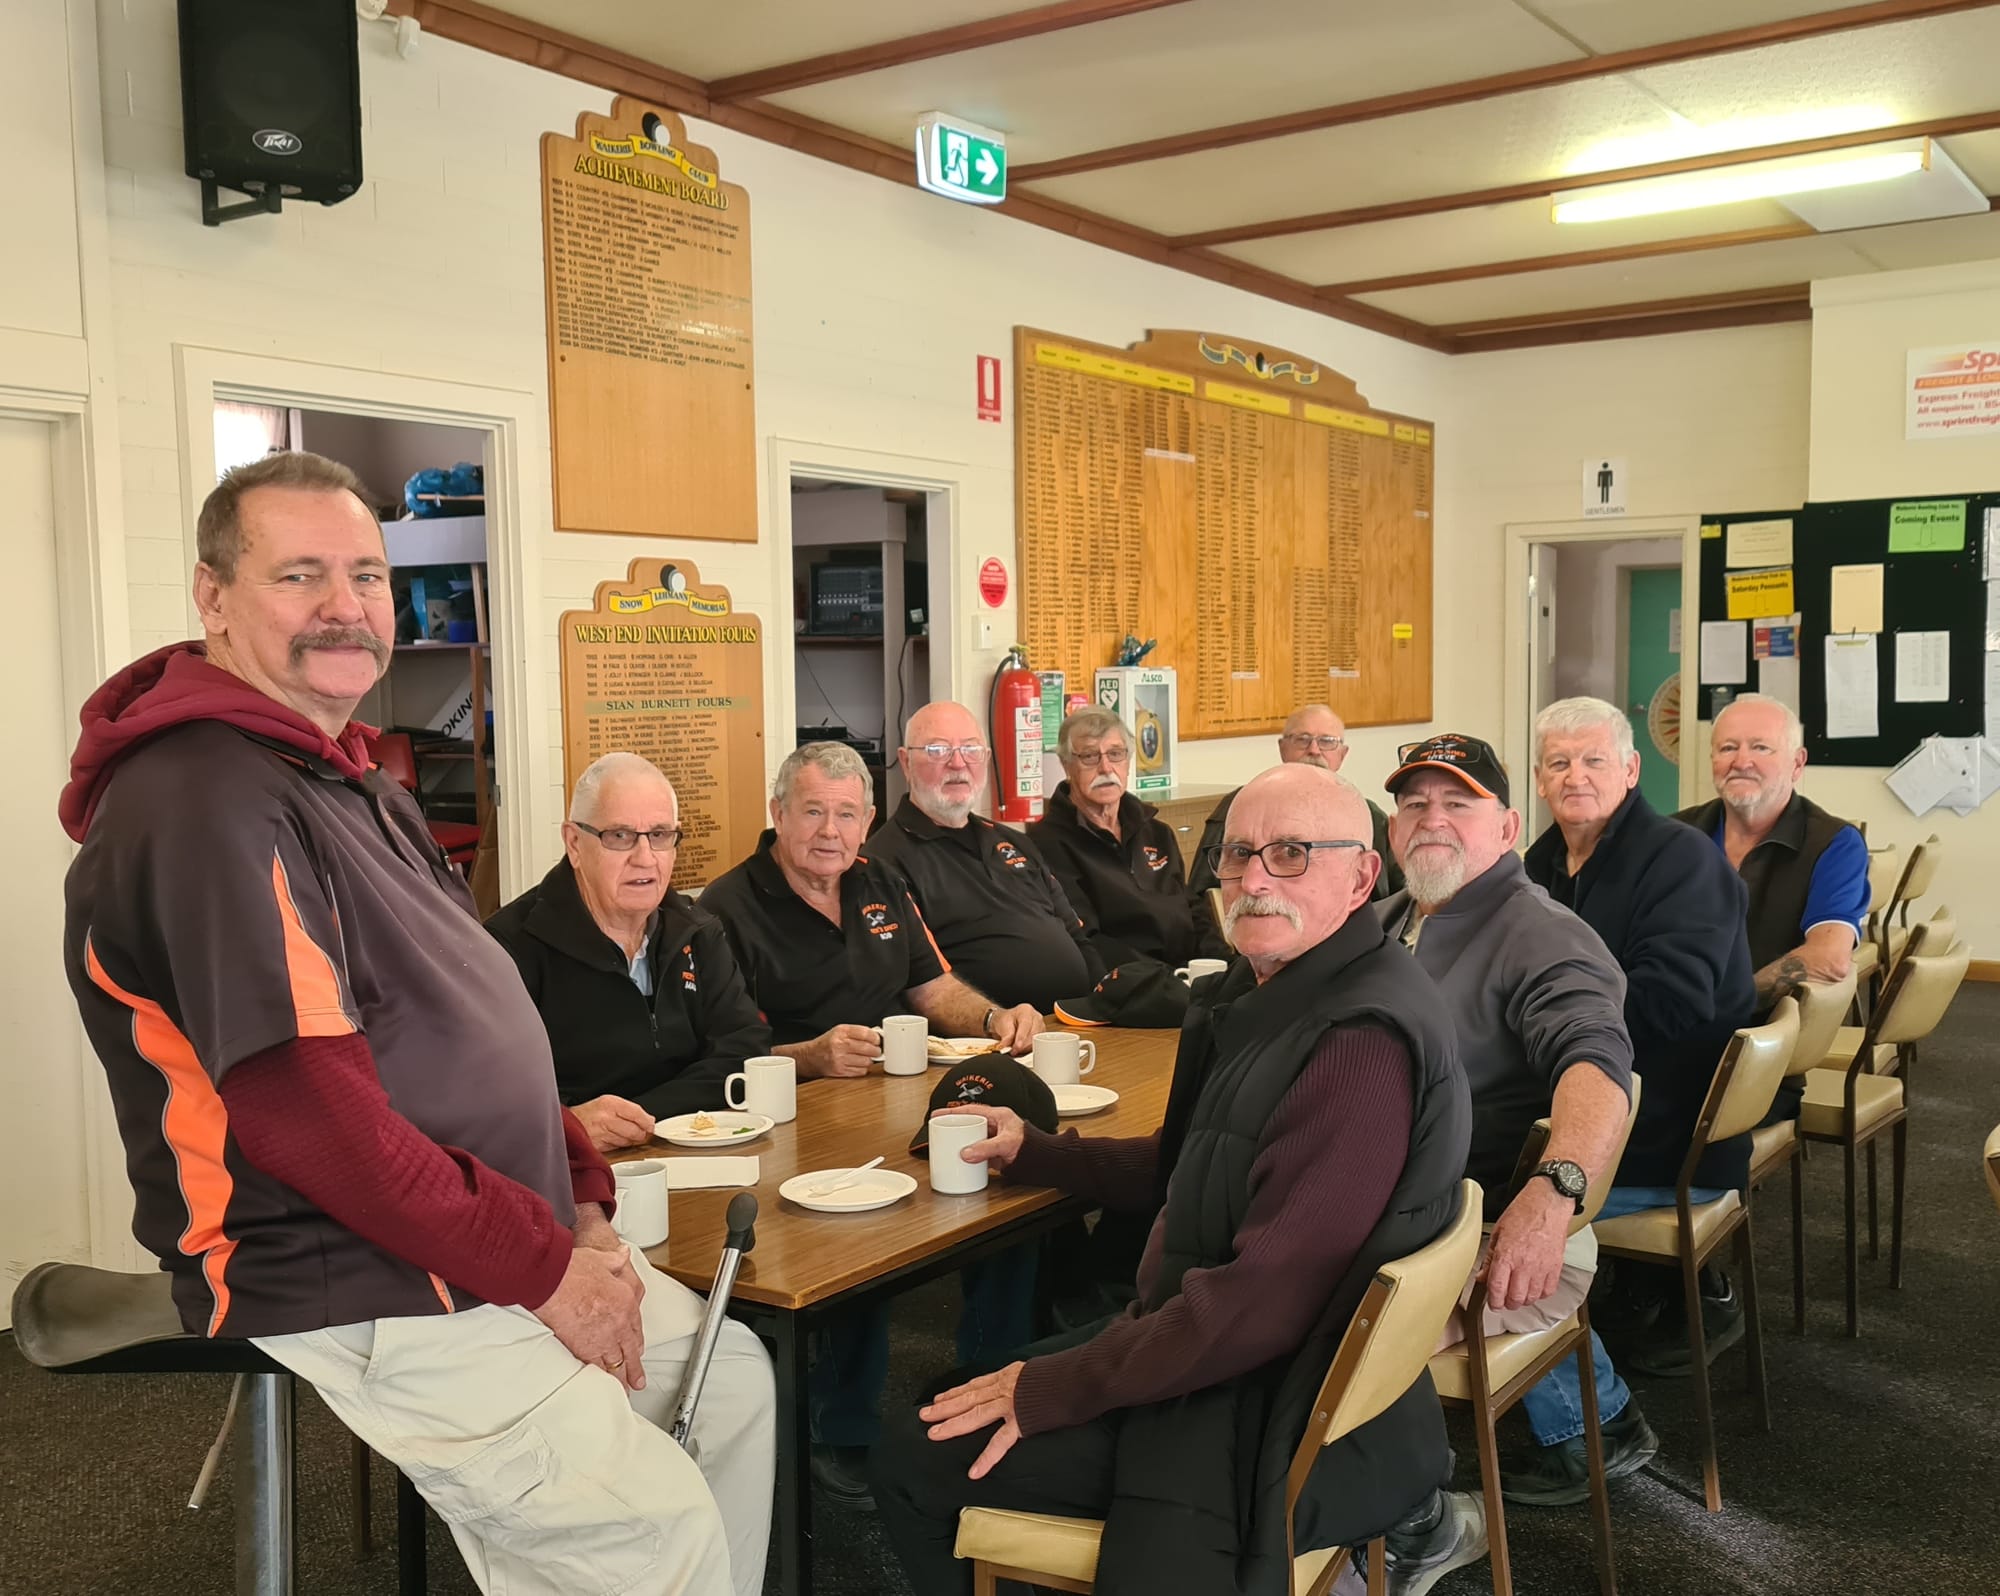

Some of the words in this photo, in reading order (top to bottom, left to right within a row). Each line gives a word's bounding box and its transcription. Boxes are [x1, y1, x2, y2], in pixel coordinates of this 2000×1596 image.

[595, 140, 632, 153] WAIKERIE
[640, 140, 677, 158] BOWLING
[689, 167, 709, 184] CLUB
[574, 154, 677, 197] ACHIEVEMENT
[680, 182, 730, 210] BOARD
[1918, 394, 1957, 403] Express
[1895, 515, 1928, 524] Coming
[1732, 585, 1759, 594] Saturday
[619, 599, 643, 609] SNOW
[654, 591, 689, 601] LEHMANN
[691, 600, 726, 612] MEMORIAL
[575, 624, 612, 643] WEST
[615, 624, 642, 643] END
[646, 624, 717, 643] INVITATION
[719, 625, 757, 643] FOURS
[1100, 680, 1118, 689] AED
[606, 700, 635, 711] STAN
[641, 698, 691, 709] BURNETT
[697, 696, 732, 707] FOURS
[955, 1074, 994, 1090] WAIKERIE
